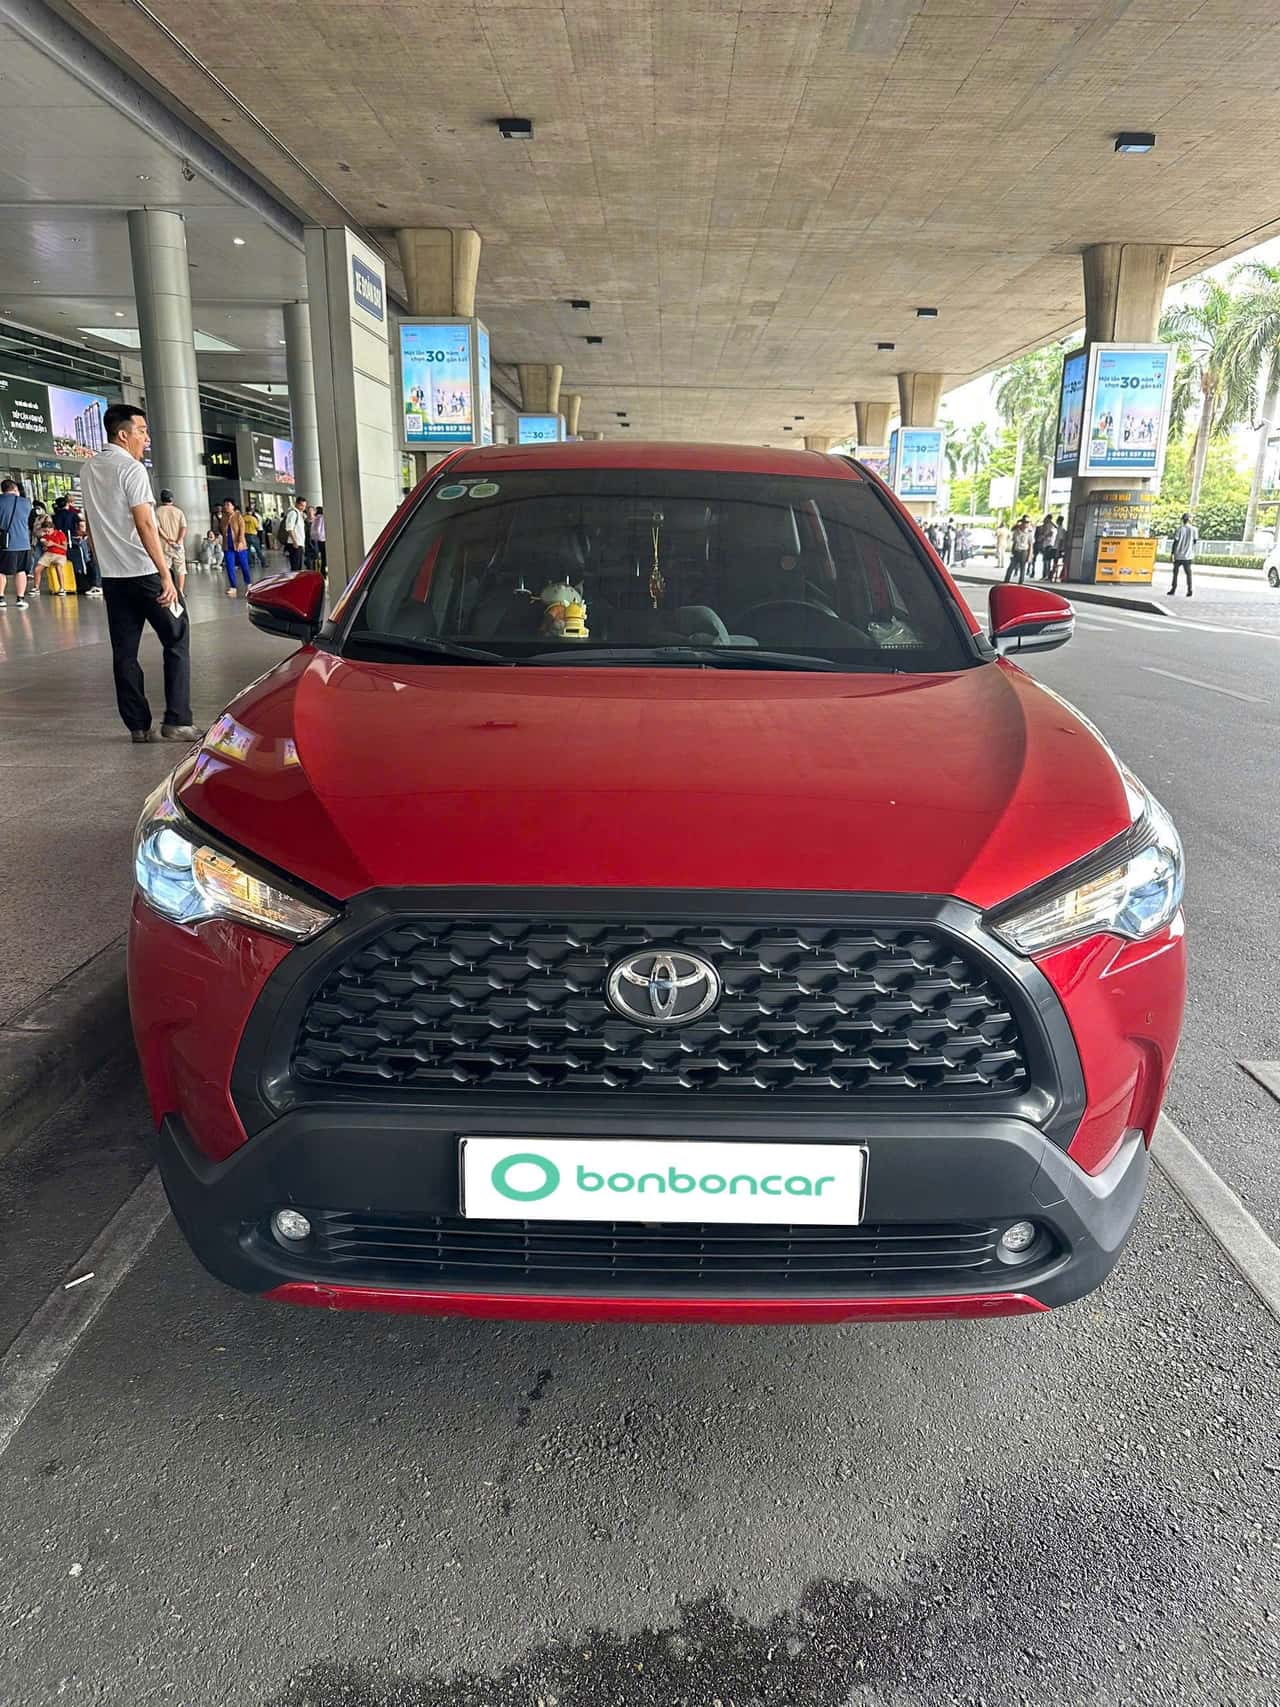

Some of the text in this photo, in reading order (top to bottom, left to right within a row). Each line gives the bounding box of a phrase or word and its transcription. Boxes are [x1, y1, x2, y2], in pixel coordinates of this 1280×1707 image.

[425, 350, 446, 362] 30
[1120, 376, 1140, 389] 30
[532, 431, 544, 439] 30
